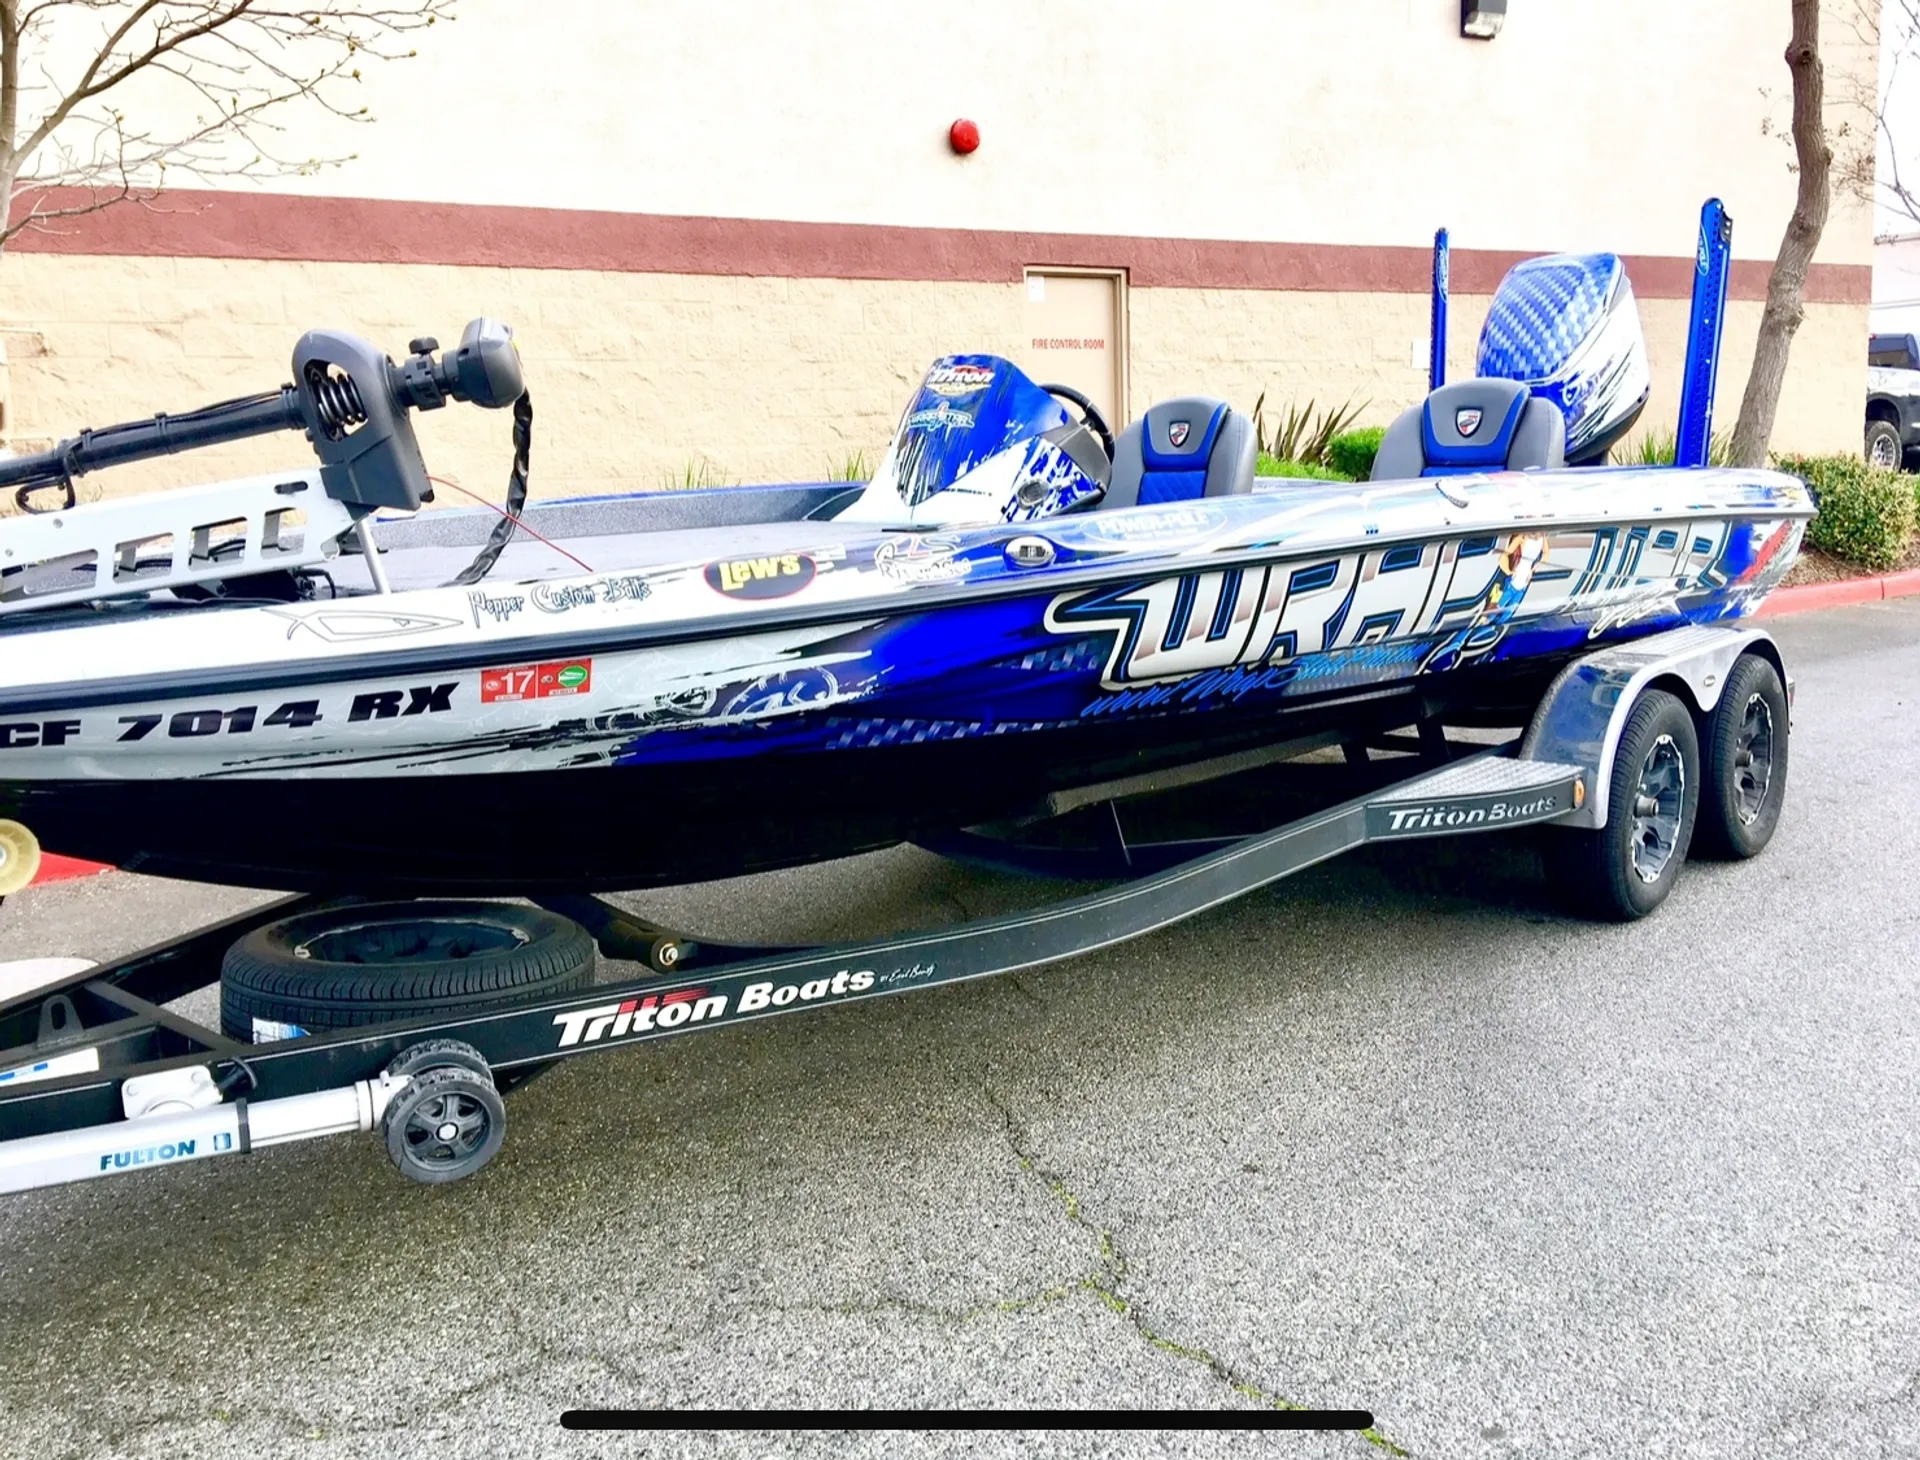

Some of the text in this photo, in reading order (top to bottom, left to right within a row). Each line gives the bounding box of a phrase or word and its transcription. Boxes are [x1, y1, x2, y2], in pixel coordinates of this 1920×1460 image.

[1032, 338, 1104, 350] FIRE CONTROL ROOM
[467, 576, 653, 629] Pepper Custom Baits
[500, 669, 536, 695] 17
[0, 682, 460, 748] CF 7014 RX
[1388, 796, 1557, 831] Triton Boats
[552, 988, 728, 1048] Triton
[736, 968, 875, 1014] Boats
[100, 1139, 196, 1171] FULTON
